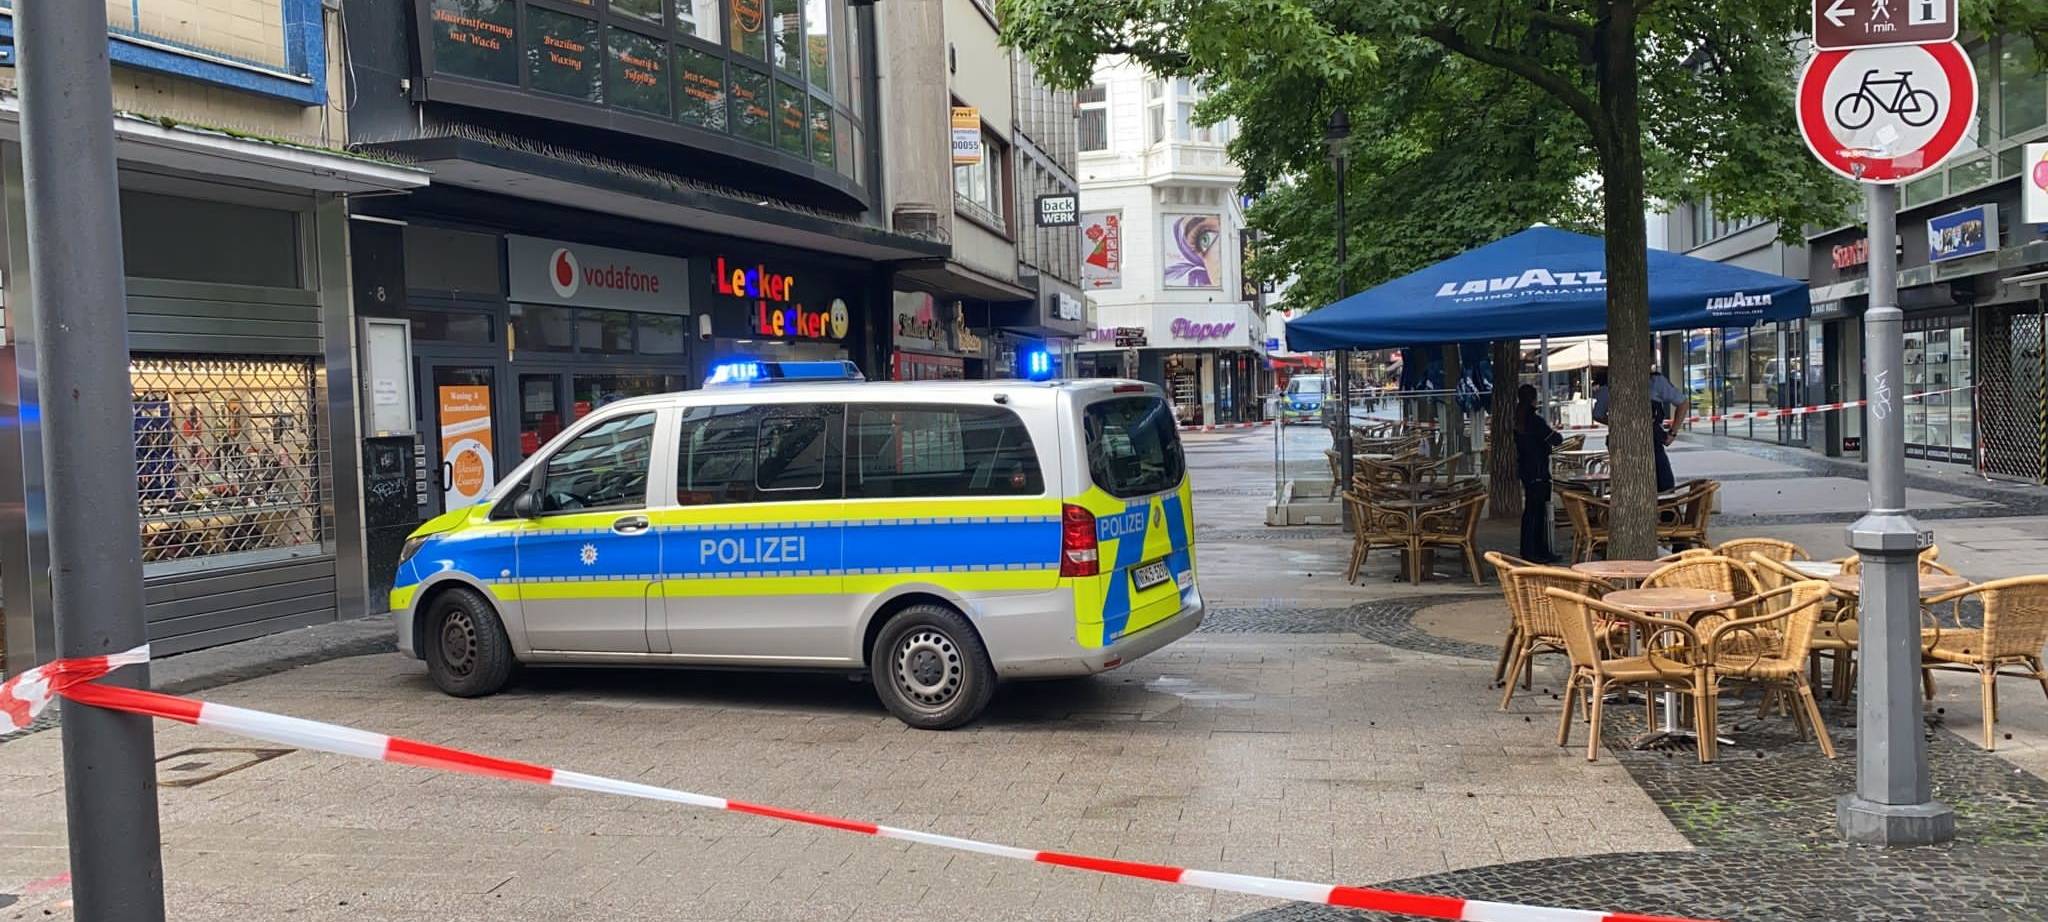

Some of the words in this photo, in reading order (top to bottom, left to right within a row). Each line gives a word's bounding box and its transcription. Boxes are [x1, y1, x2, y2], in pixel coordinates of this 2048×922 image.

[433, 9, 513, 39] Haarentfernung
[1864, 22, 1869, 33] 1
[1873, 22, 1897, 33] min.
[550, 52, 582, 71] Waxing
[1042, 213, 1075, 223] WERK
[1044, 199, 1073, 211] back
[584, 264, 660, 293] vodafone
[716, 256, 794, 301] Lecker
[1435, 268, 1608, 297] LAVAZZ
[1706, 291, 1772, 310] LAVAZZA
[758, 301, 830, 339] Lecker
[1171, 317, 1236, 342] Pieper
[1101, 512, 1144, 539] POLIZEI
[700, 536, 805, 565] POLIZEI
